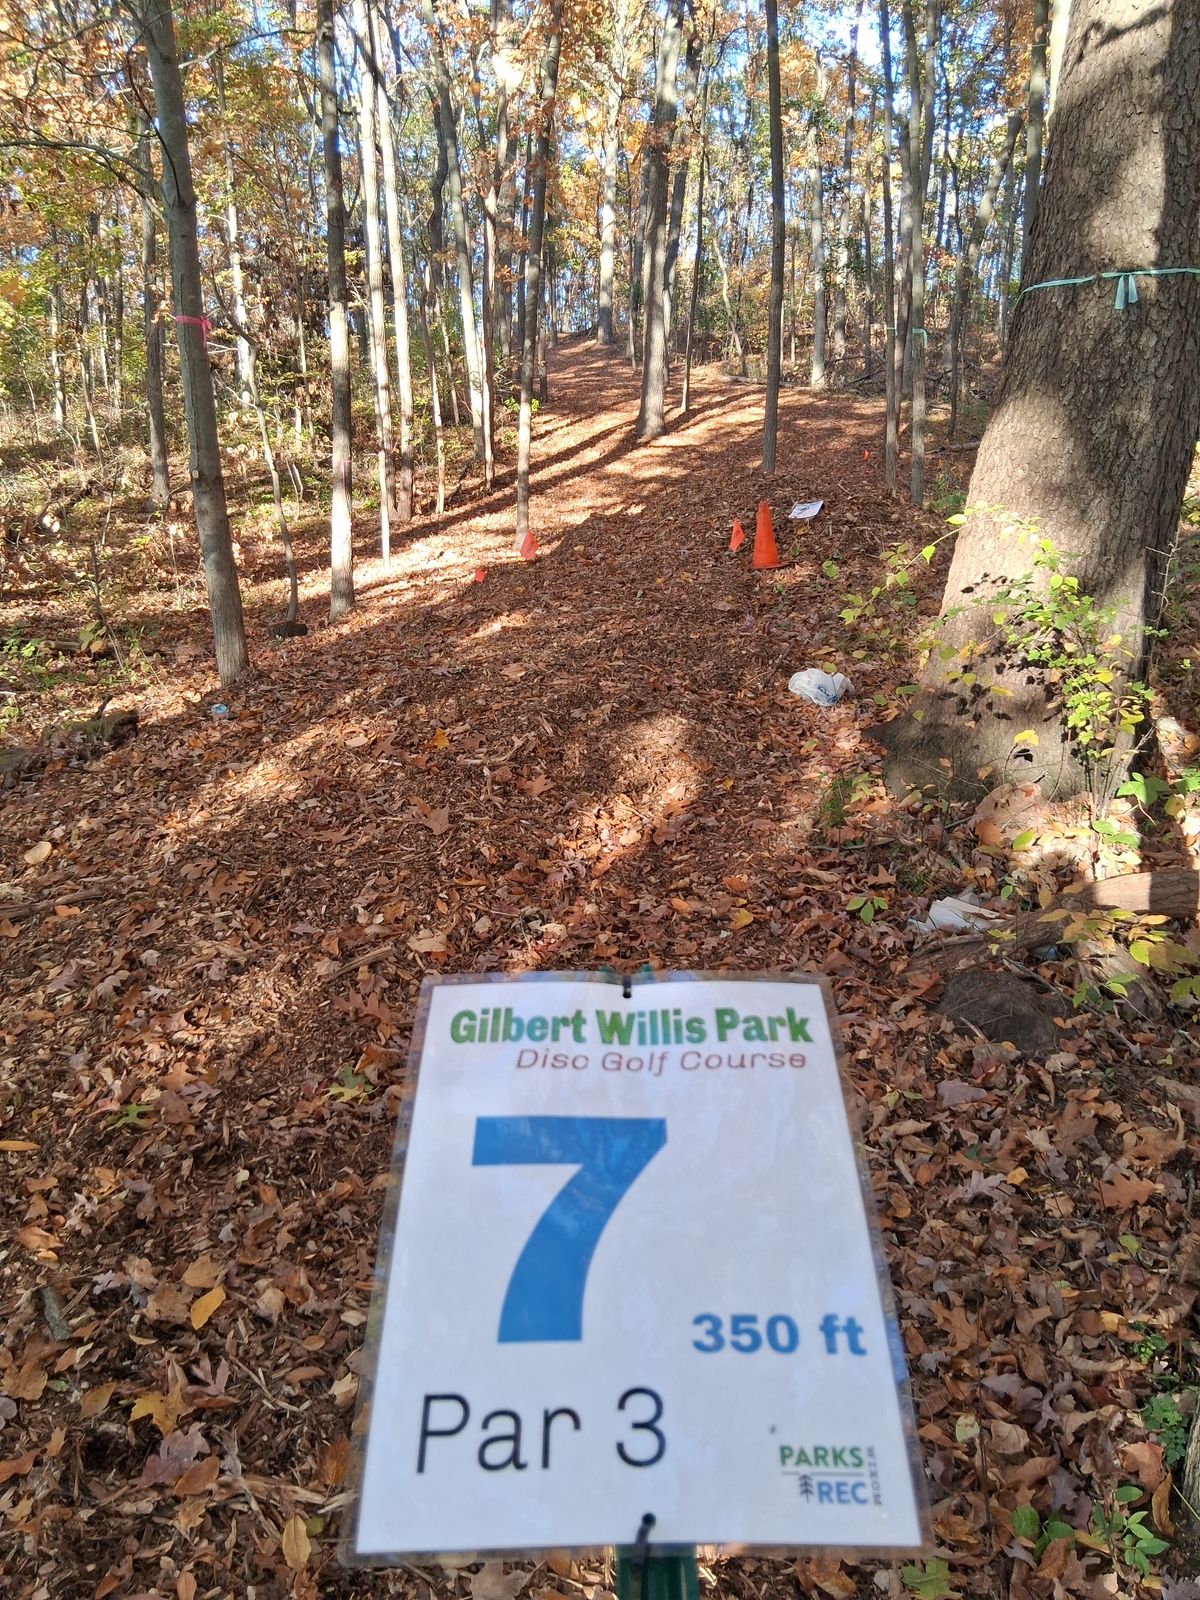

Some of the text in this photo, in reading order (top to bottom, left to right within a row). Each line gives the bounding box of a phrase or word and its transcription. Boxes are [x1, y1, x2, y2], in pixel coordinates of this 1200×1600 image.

[451, 1006, 814, 1046] Gilbert Willis Park
[516, 1048, 807, 1077] Disc Golf Course
[471, 1115, 668, 1344] 7
[692, 1313, 868, 1356] 350 ft
[416, 1387, 667, 1474] Par 3
[779, 1445, 865, 1468] PARKS
[816, 1481, 869, 1505] REC
